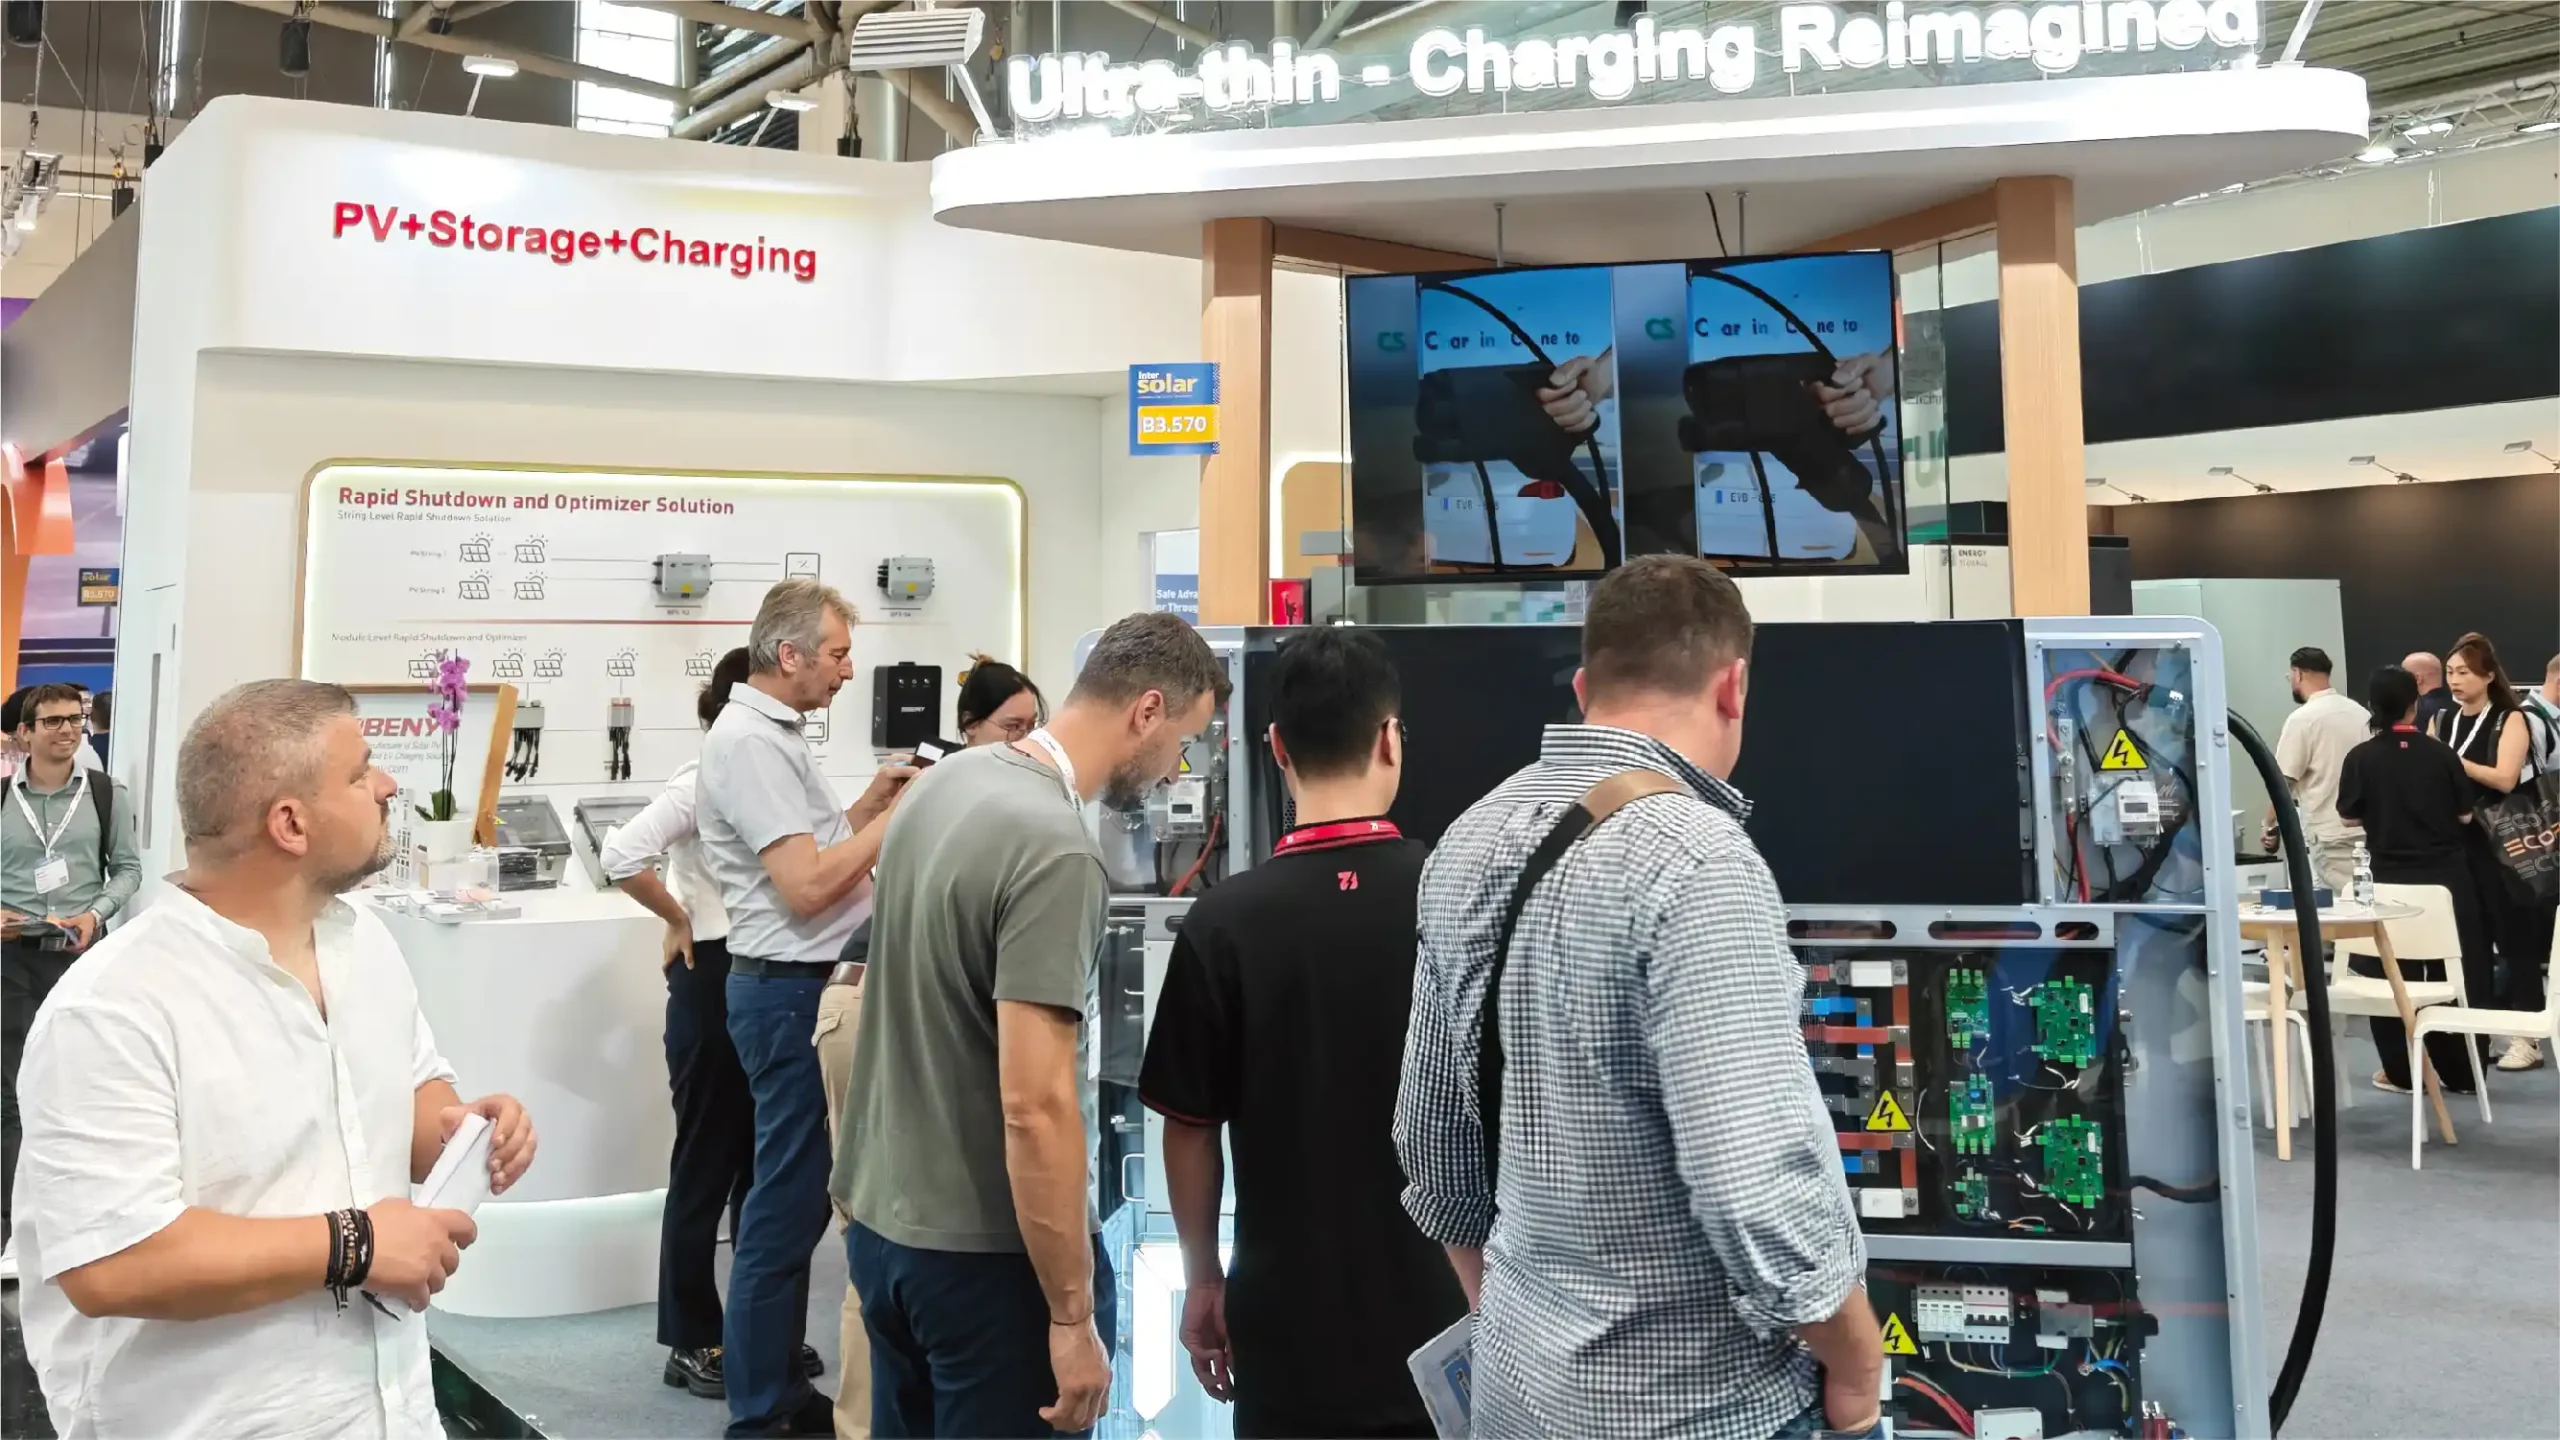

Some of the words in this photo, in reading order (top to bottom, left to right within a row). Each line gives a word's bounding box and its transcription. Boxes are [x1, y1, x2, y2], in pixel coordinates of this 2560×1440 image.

[1008, 40, 1341, 121] Ultra-thin
[1408, 16, 1760, 98] Charging
[1780, 0, 2262, 73] Reimagined
[332, 201, 817, 283] PV+Storage+Charging
[1137, 373, 1199, 394] solar
[1138, 371, 1160, 380] Inter
[1142, 416, 1207, 433] B3.570
[339, 487, 399, 509] Rapid
[405, 489, 507, 509] Shutdown
[513, 493, 549, 509] and
[555, 494, 651, 514] Optimizer
[656, 497, 734, 515] Solution
[338, 510, 367, 521] String
[369, 511, 395, 521] Level
[397, 512, 423, 522] Rapid
[474, 513, 512, 523] Solution
[1958, 549, 1987, 557] ENERGY
[1156, 589, 1176, 599] Safe
[360, 717, 440, 737] BENY
